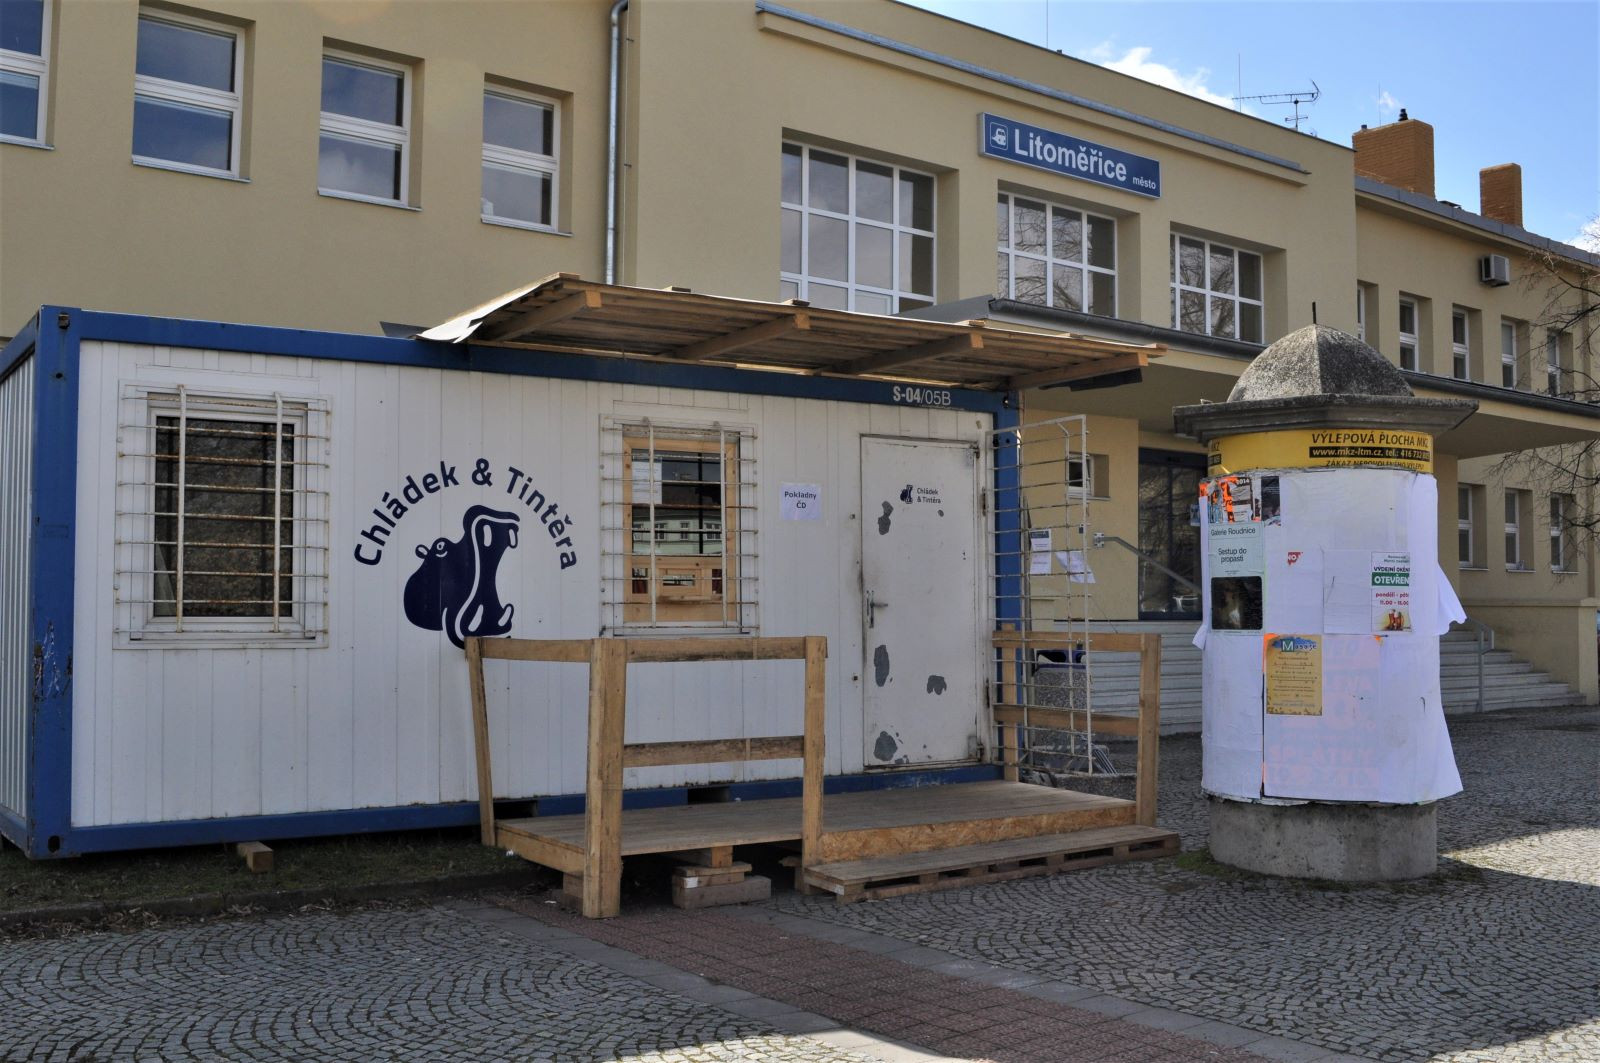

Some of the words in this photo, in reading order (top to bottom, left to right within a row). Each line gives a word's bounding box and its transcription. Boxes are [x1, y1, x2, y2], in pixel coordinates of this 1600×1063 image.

[1014, 129, 1127, 182] Litoměřice
[1132, 176, 1156, 190] město
[893, 385, 951, 406] S-04/05B
[1312, 431, 1375, 444] VÝLEPOVÁ
[1379, 434, 1415, 447] PLOCHA
[784, 491, 817, 500] Pokladny
[796, 499, 807, 509] ČD
[354, 461, 459, 566] Chládek
[471, 458, 493, 487] &
[506, 466, 577, 570] Tintěra
[1228, 527, 1256, 535] Roudnice
[1218, 547, 1238, 556] Sestup
[1220, 555, 1244, 563] propasti
